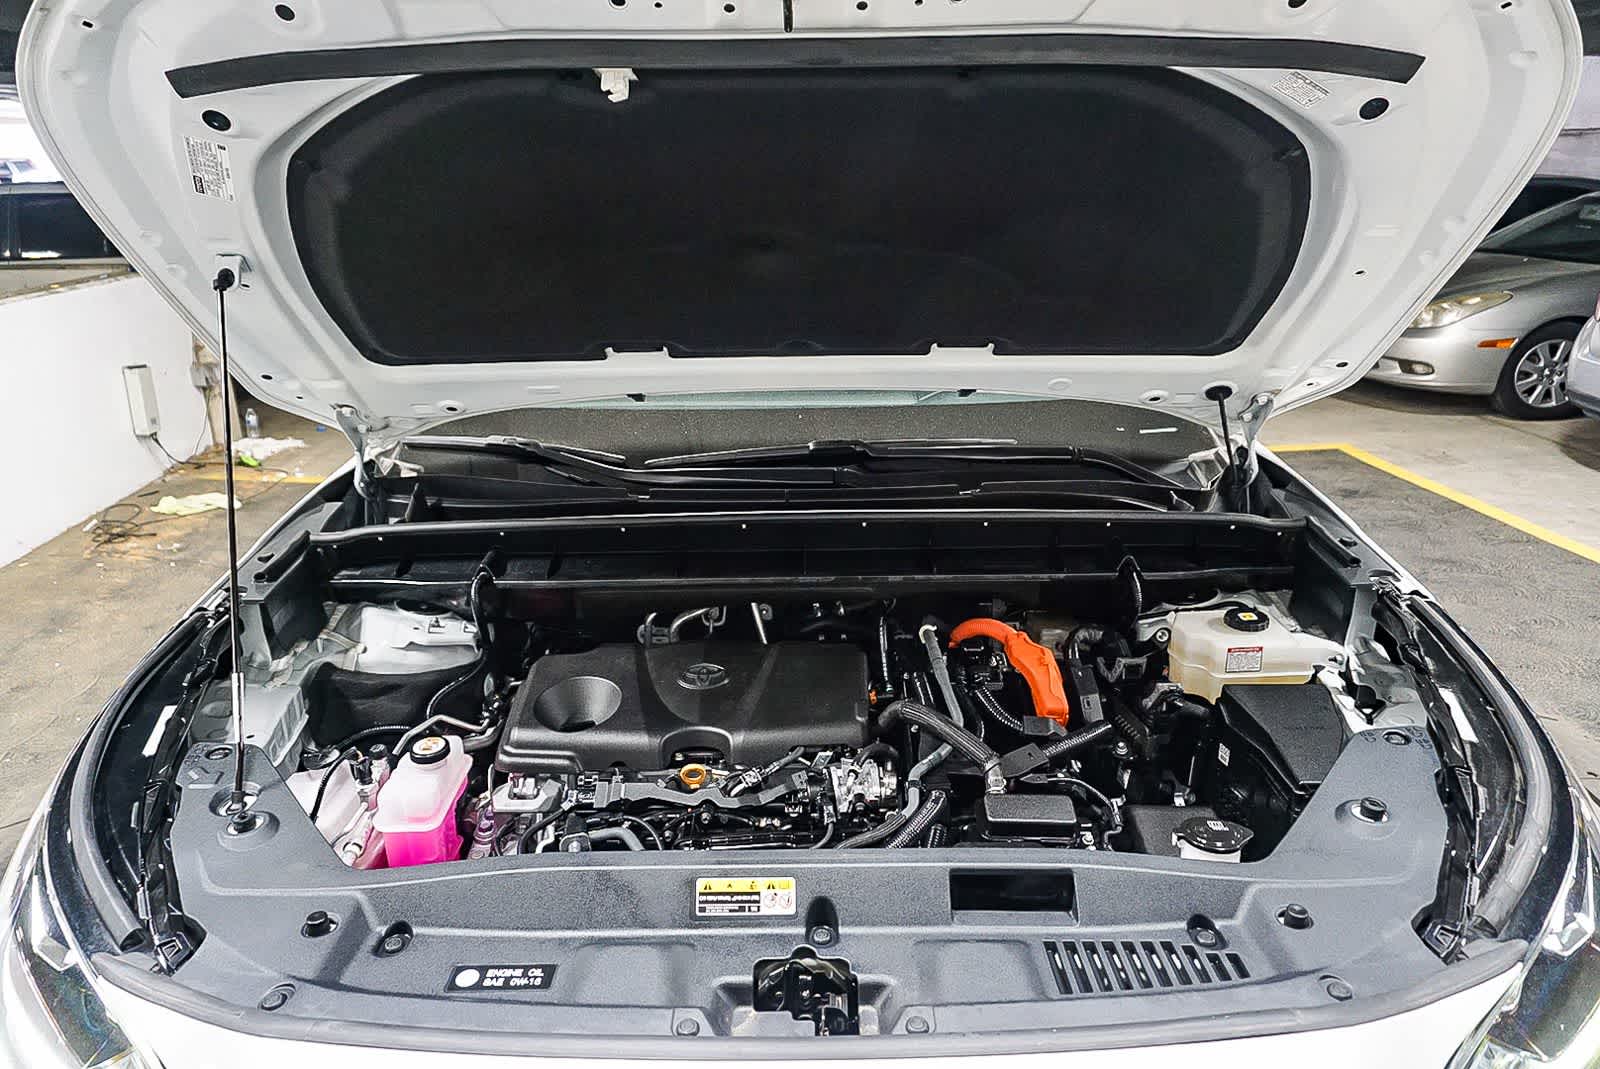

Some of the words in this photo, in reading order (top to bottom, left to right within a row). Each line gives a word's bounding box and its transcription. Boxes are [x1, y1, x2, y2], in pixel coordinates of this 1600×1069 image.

[486, 968, 524, 977] ENGINE
[528, 968, 544, 977] OIL
[482, 977, 505, 987] SAE
